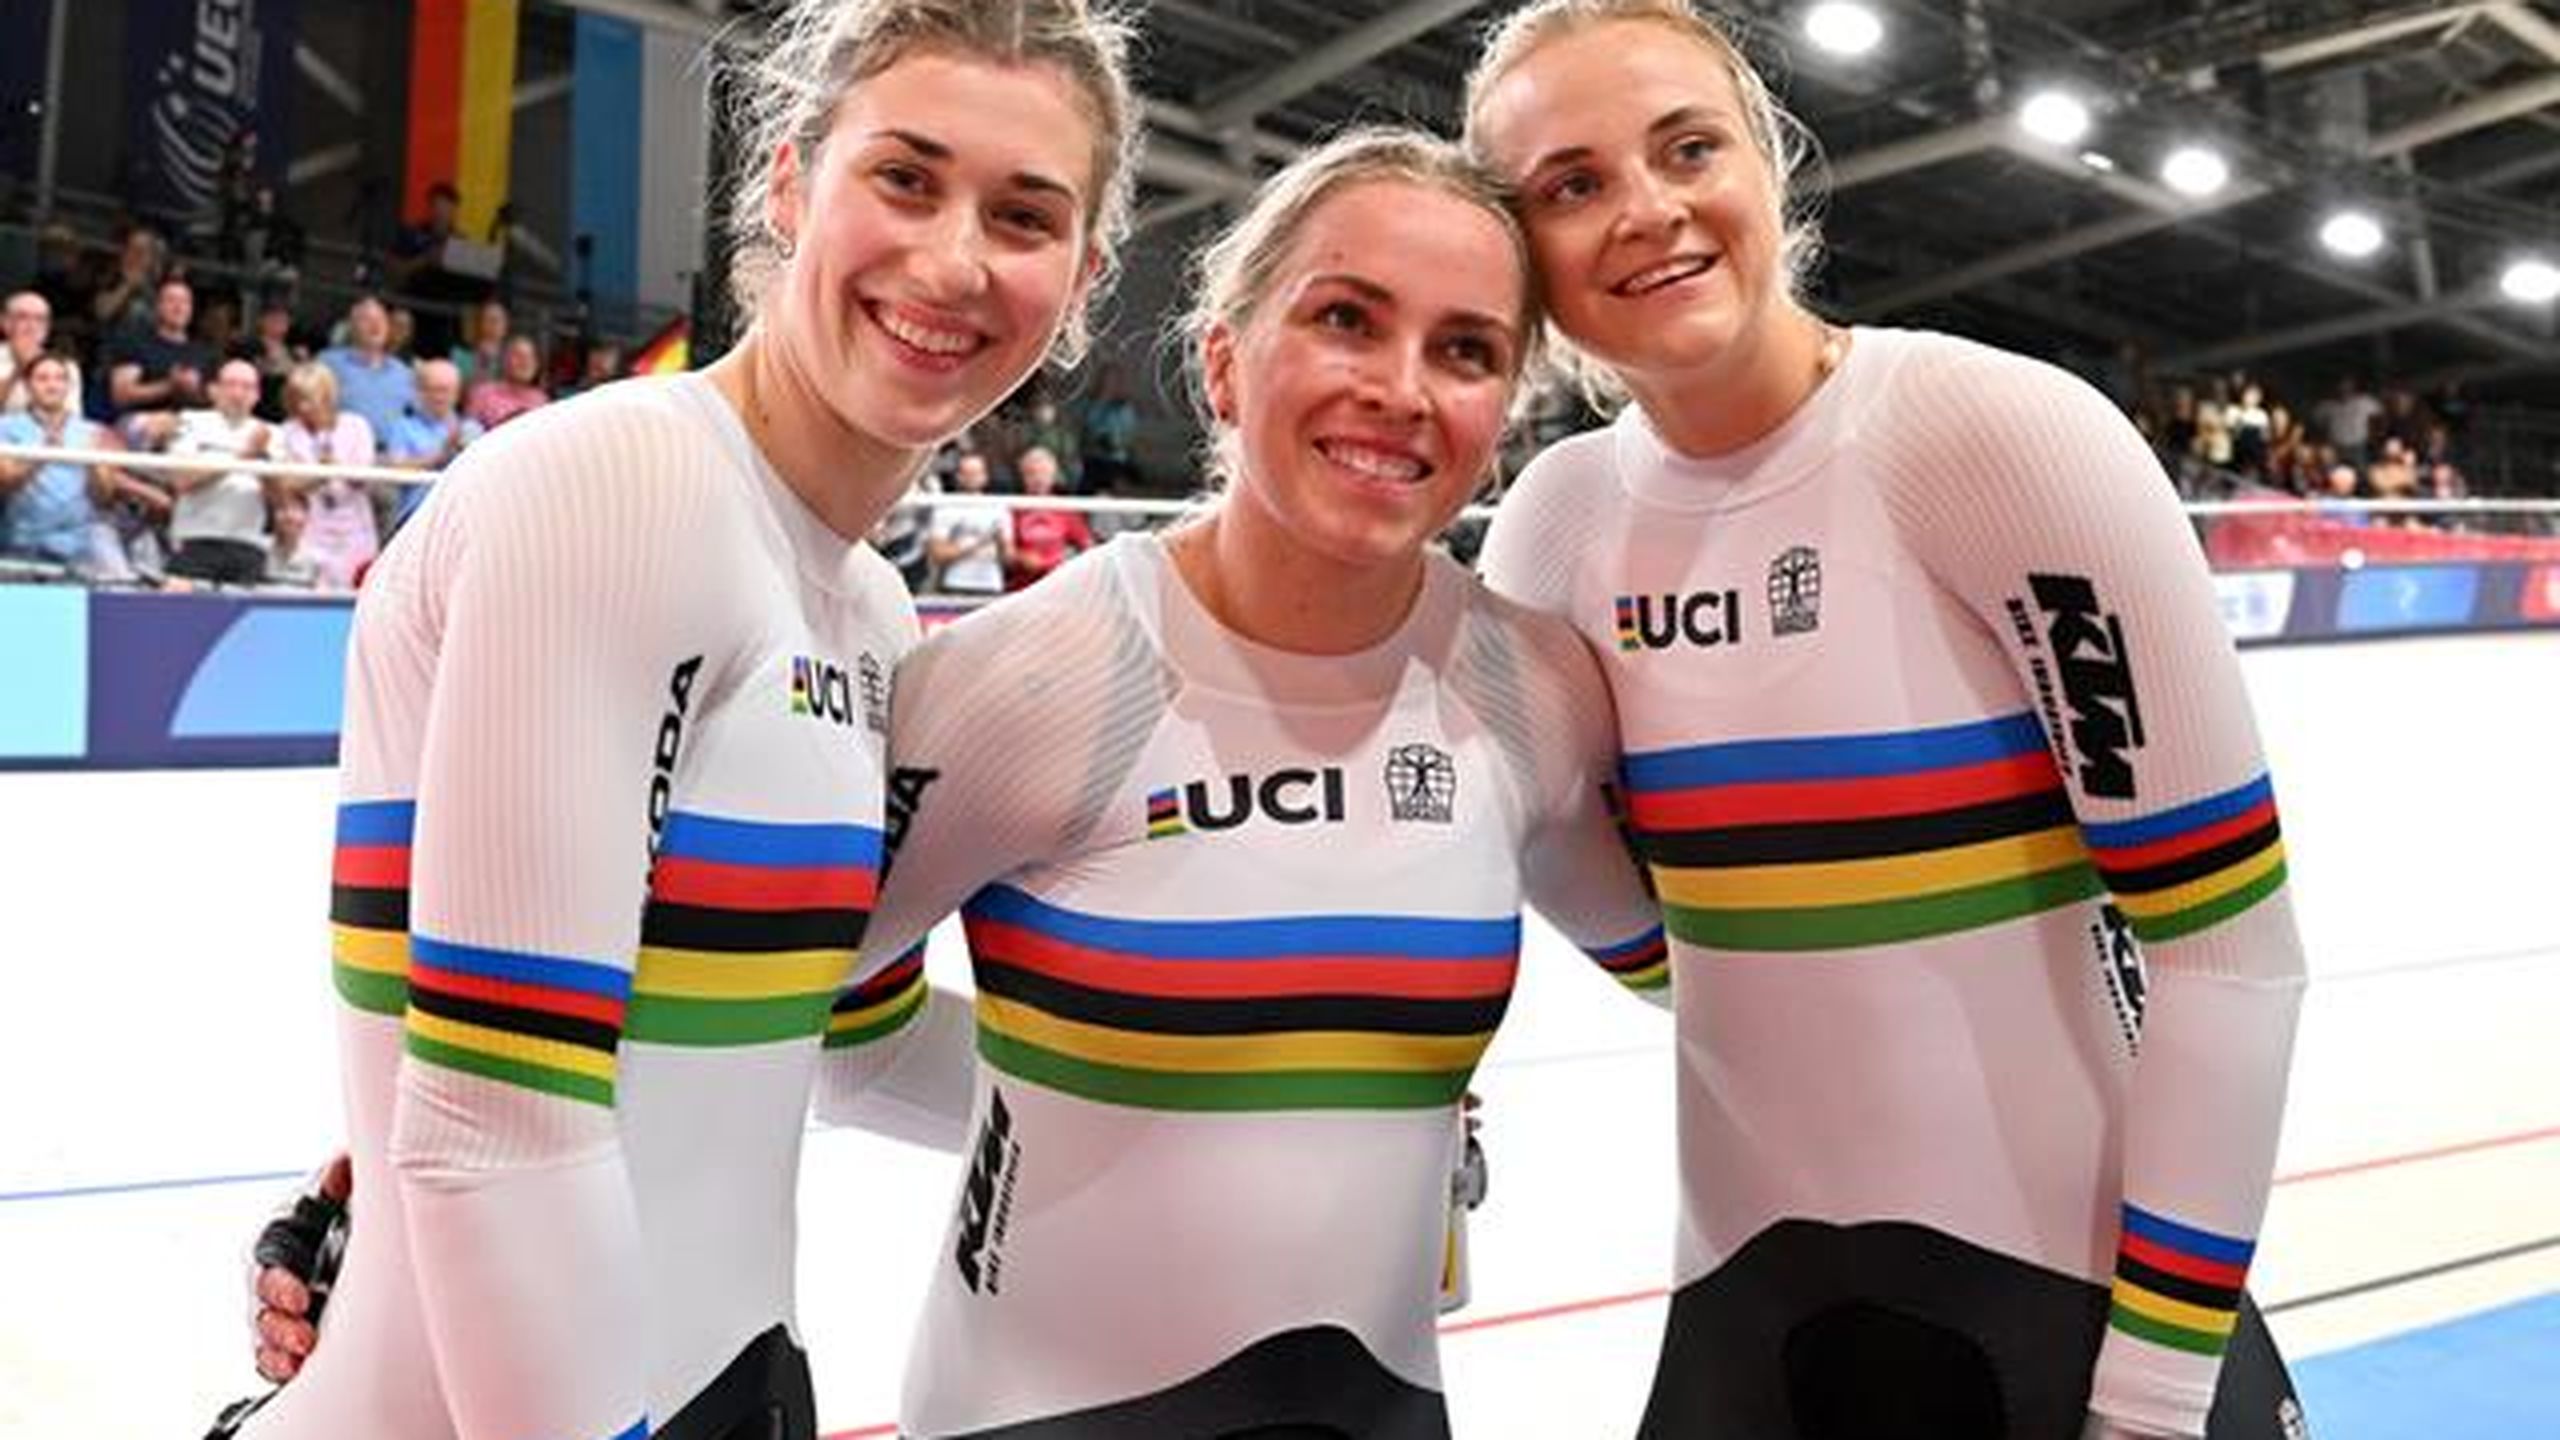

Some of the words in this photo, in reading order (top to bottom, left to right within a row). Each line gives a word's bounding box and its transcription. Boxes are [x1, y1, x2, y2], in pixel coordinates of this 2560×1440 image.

[194, 0, 238, 96] UE
[1636, 590, 1741, 649] UCI
[804, 656, 853, 726] UCI
[2028, 571, 2146, 800] KTM
[1186, 767, 1346, 831] UCI
